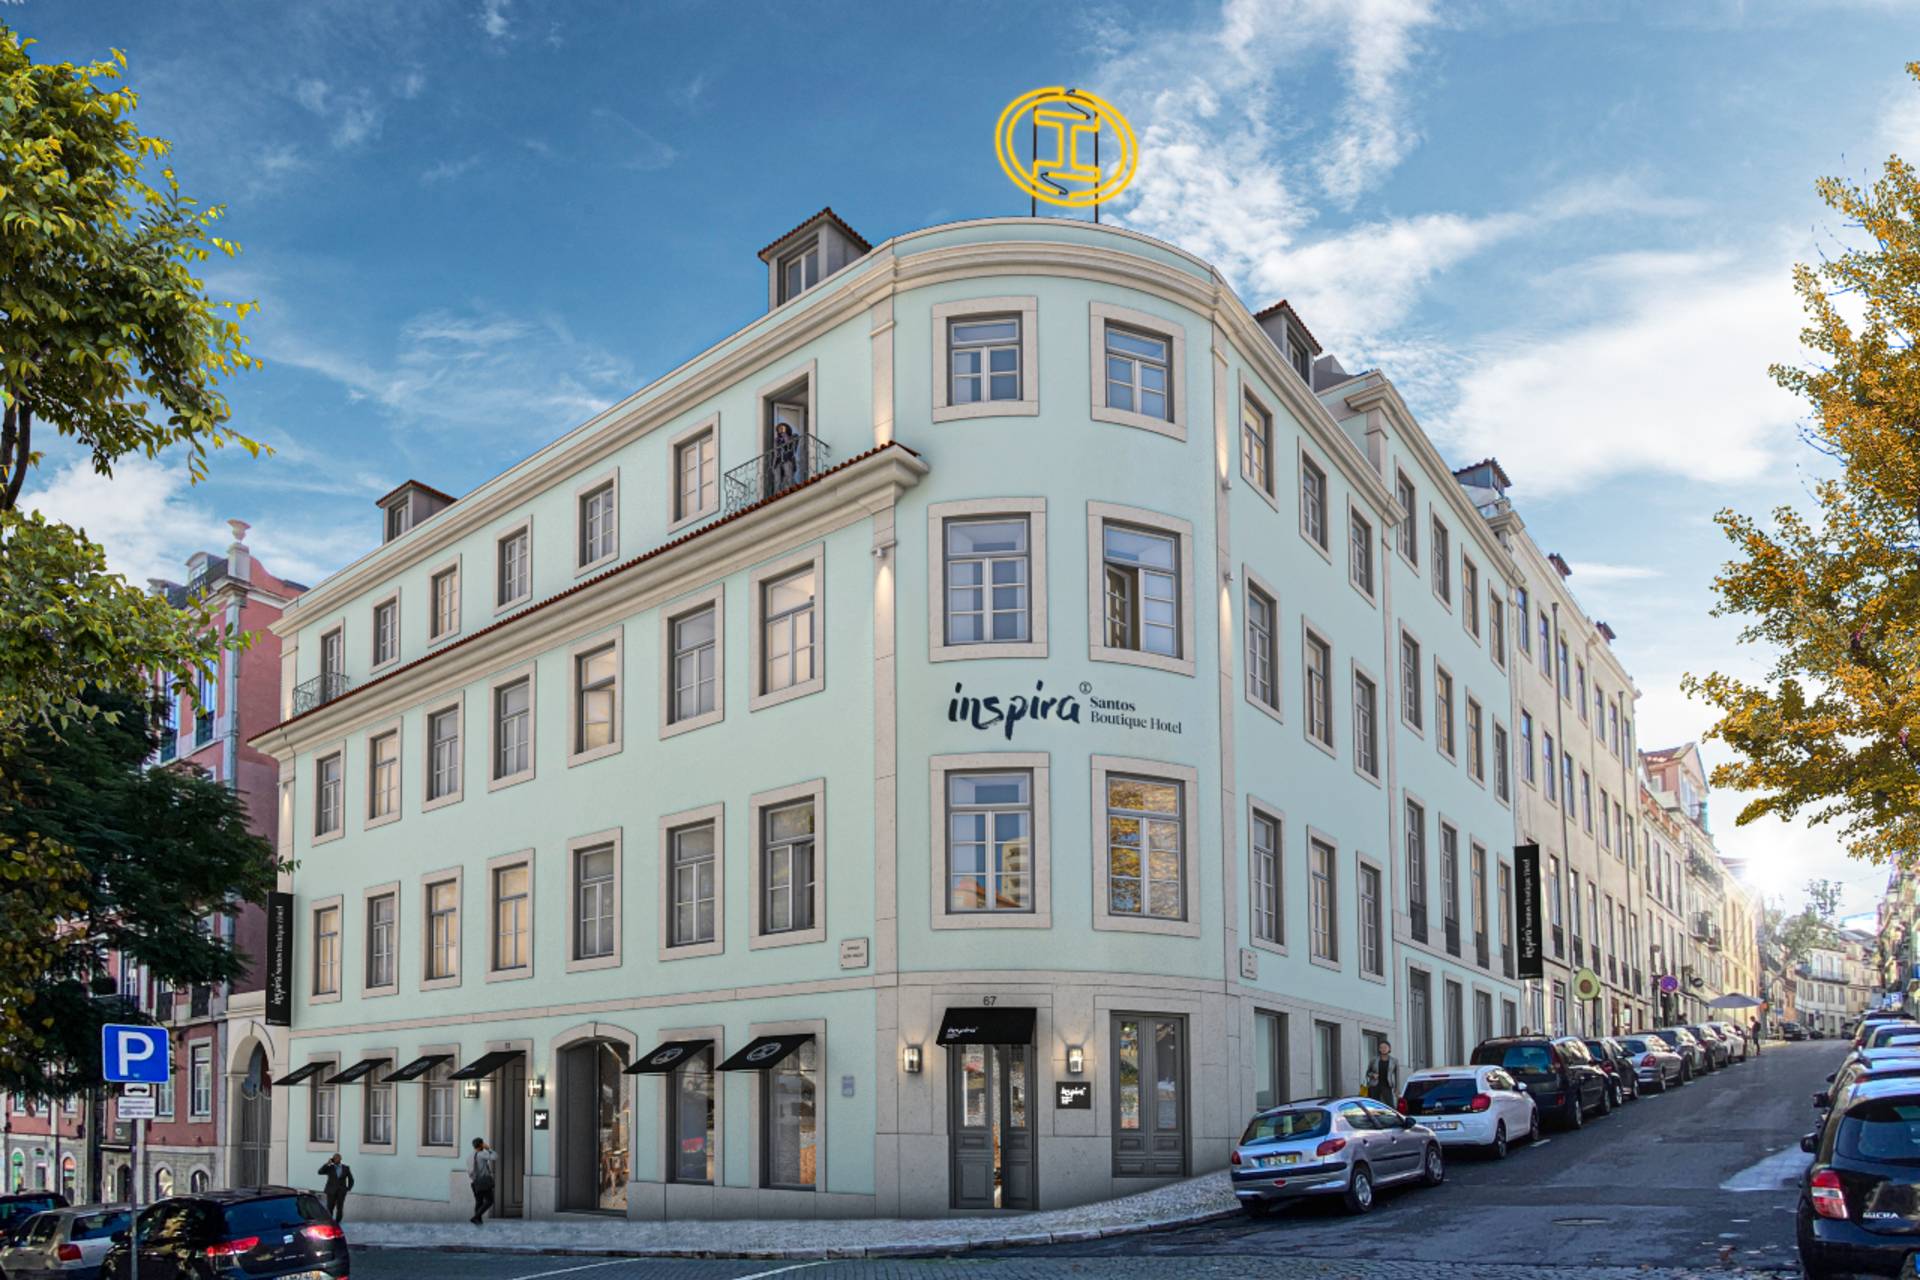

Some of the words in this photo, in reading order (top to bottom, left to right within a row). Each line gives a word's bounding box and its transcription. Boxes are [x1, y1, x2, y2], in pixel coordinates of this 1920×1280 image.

[948, 680, 1080, 740] inspira
[1090, 696, 1136, 712] Santos
[1091, 711, 1147, 730] Boutique
[1150, 717, 1182, 734] Hotel
[983, 996, 997, 1006] 67
[118, 1031, 155, 1077] P
